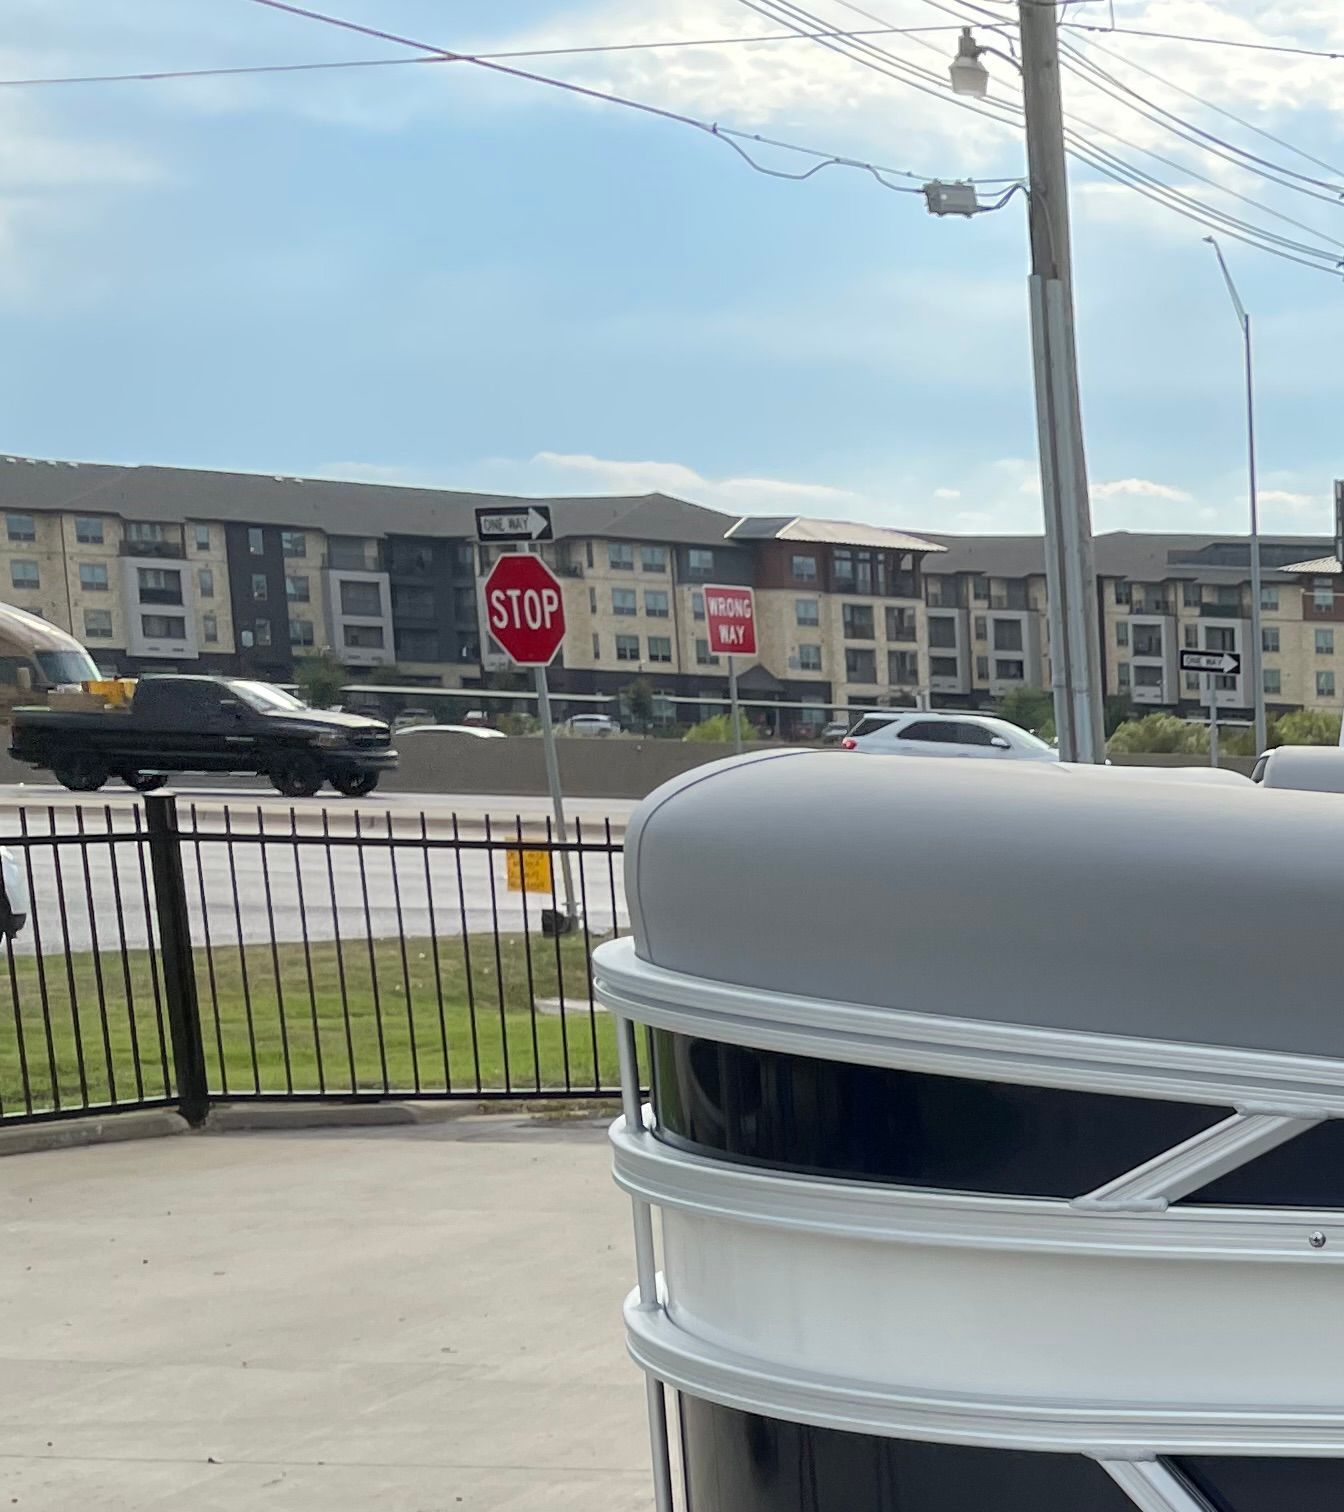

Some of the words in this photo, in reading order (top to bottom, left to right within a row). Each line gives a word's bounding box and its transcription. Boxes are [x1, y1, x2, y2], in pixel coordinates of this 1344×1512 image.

[483, 517, 505, 532] ONE
[508, 516, 530, 530] WAY
[491, 588, 559, 630] STOP
[707, 596, 752, 618] WRONG
[718, 624, 745, 645] WAY
